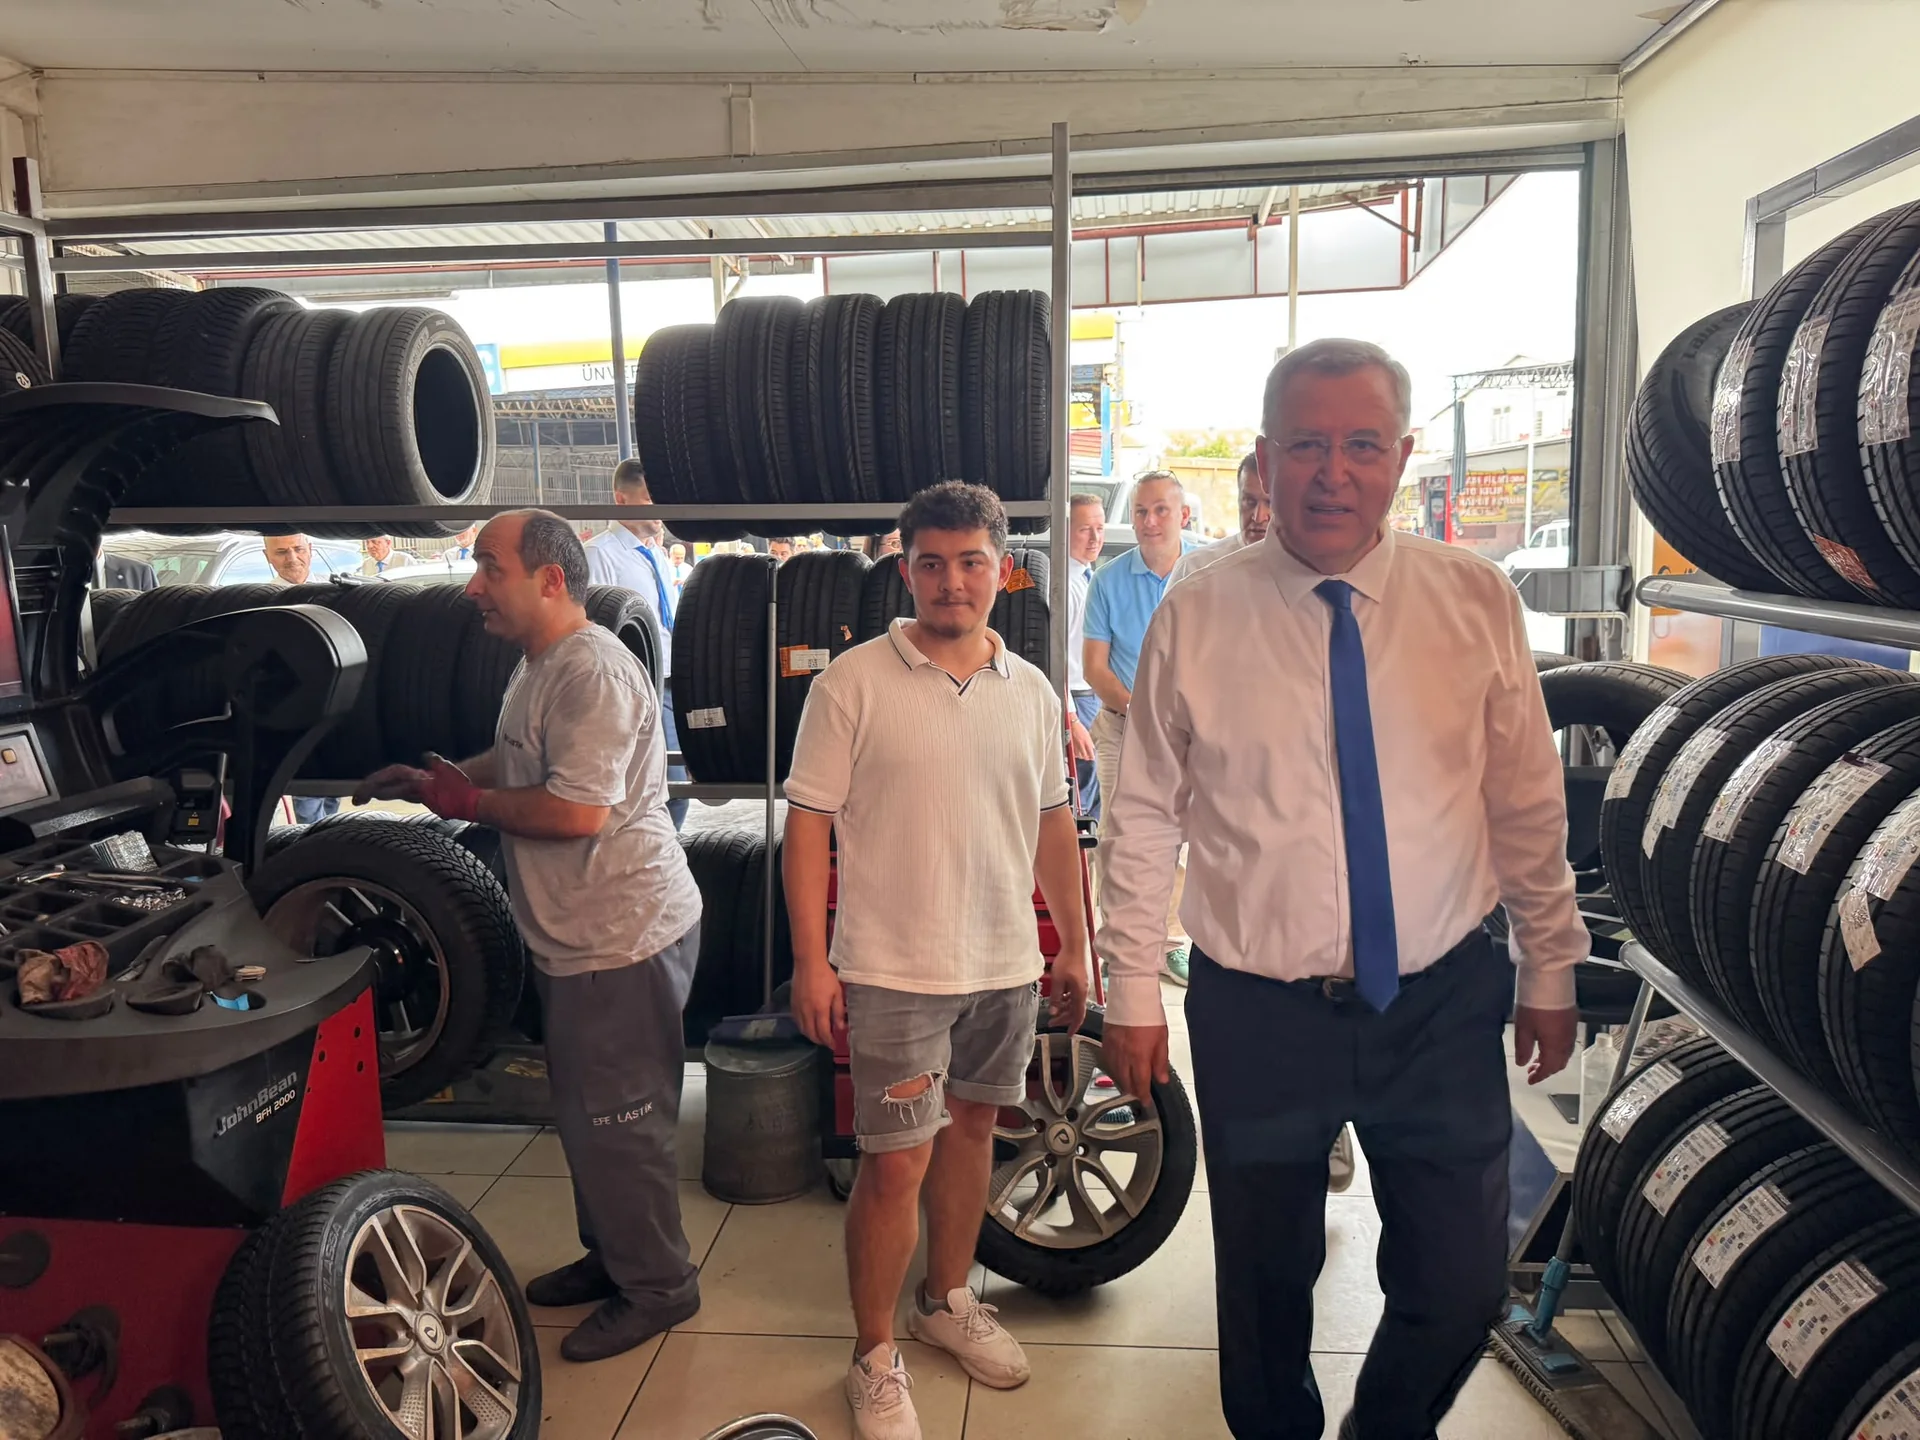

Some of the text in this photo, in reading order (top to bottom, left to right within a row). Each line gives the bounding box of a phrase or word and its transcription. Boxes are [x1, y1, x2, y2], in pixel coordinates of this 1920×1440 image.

[217, 1072, 298, 1136] JohnBean
[256, 1089, 296, 1123] BFH 2000
[593, 1115, 611, 1126] EFE
